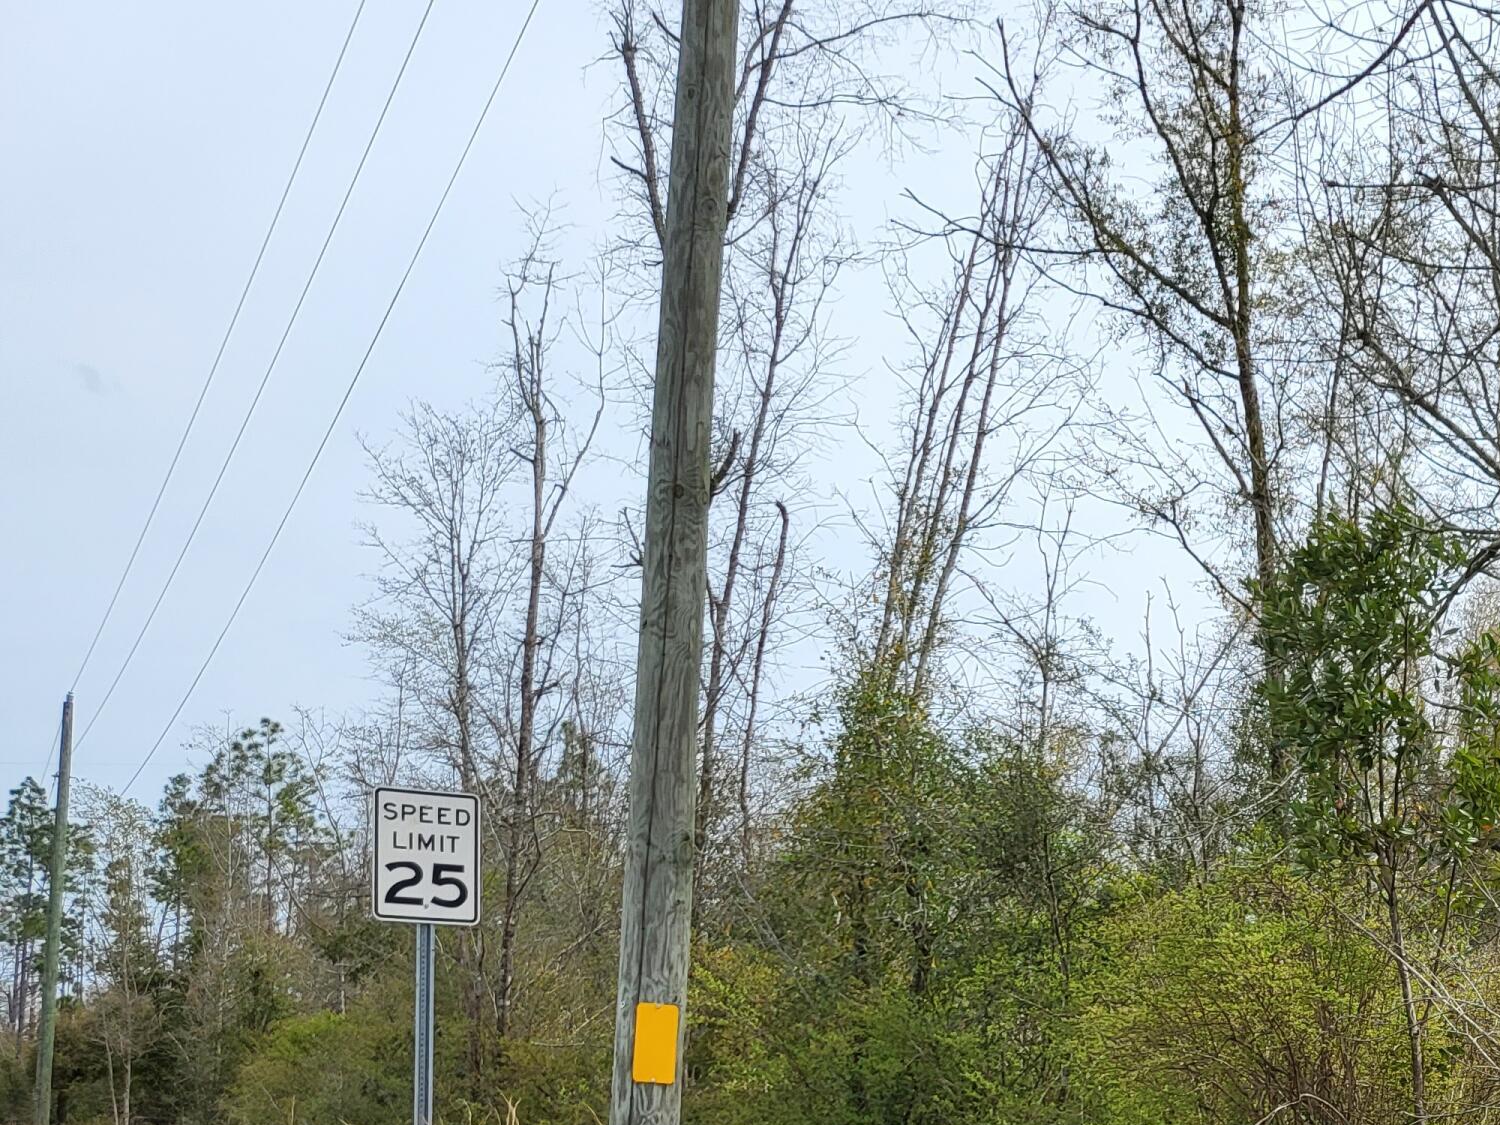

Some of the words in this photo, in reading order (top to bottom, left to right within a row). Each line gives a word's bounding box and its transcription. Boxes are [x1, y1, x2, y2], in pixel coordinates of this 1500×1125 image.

[383, 802, 471, 826] SPEED
[393, 831, 460, 853] LIMIT
[384, 861, 468, 908] 25
